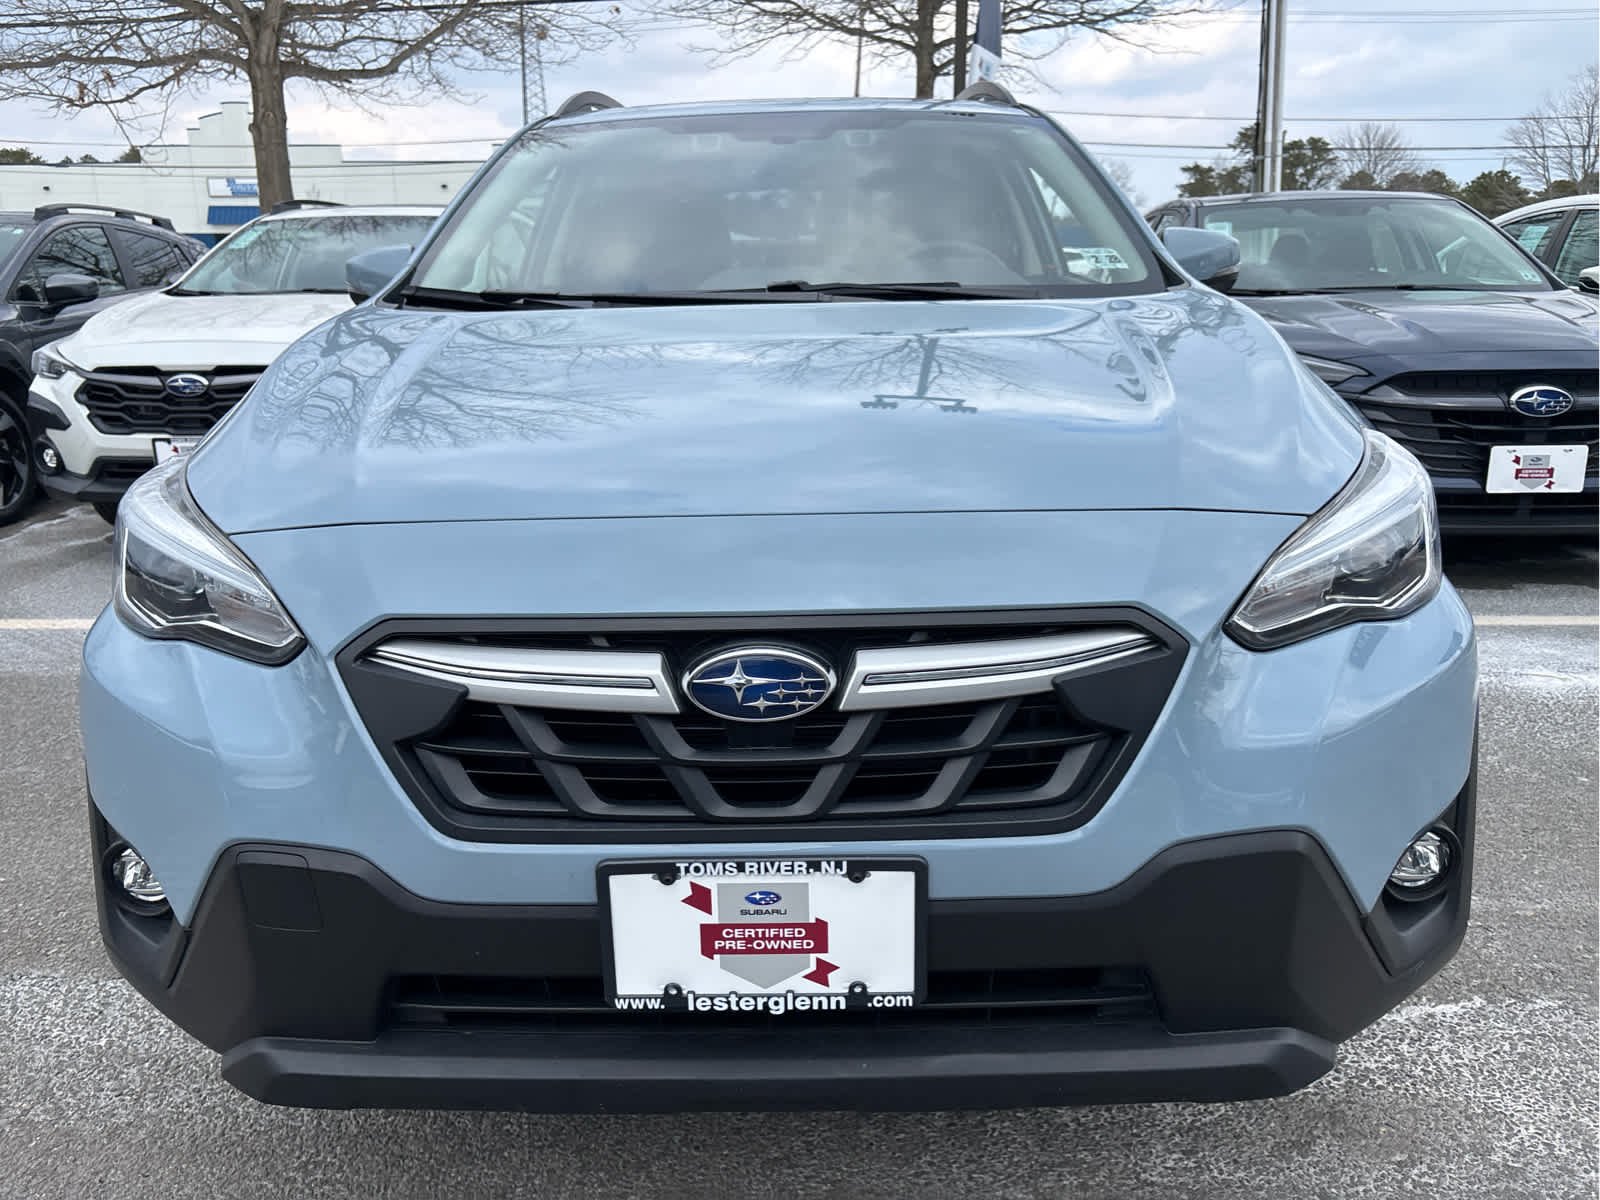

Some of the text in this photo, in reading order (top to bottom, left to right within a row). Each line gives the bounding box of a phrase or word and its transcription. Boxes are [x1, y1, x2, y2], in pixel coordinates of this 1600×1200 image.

[676, 862, 738, 877] TOMS
[820, 860, 848, 875] NJ
[739, 908, 788, 916] SUBARU
[721, 927, 806, 938] CERTIFIED
[714, 939, 815, 950] PRE-OWNED
[614, 993, 913, 1015] www. lesterglenn .com
